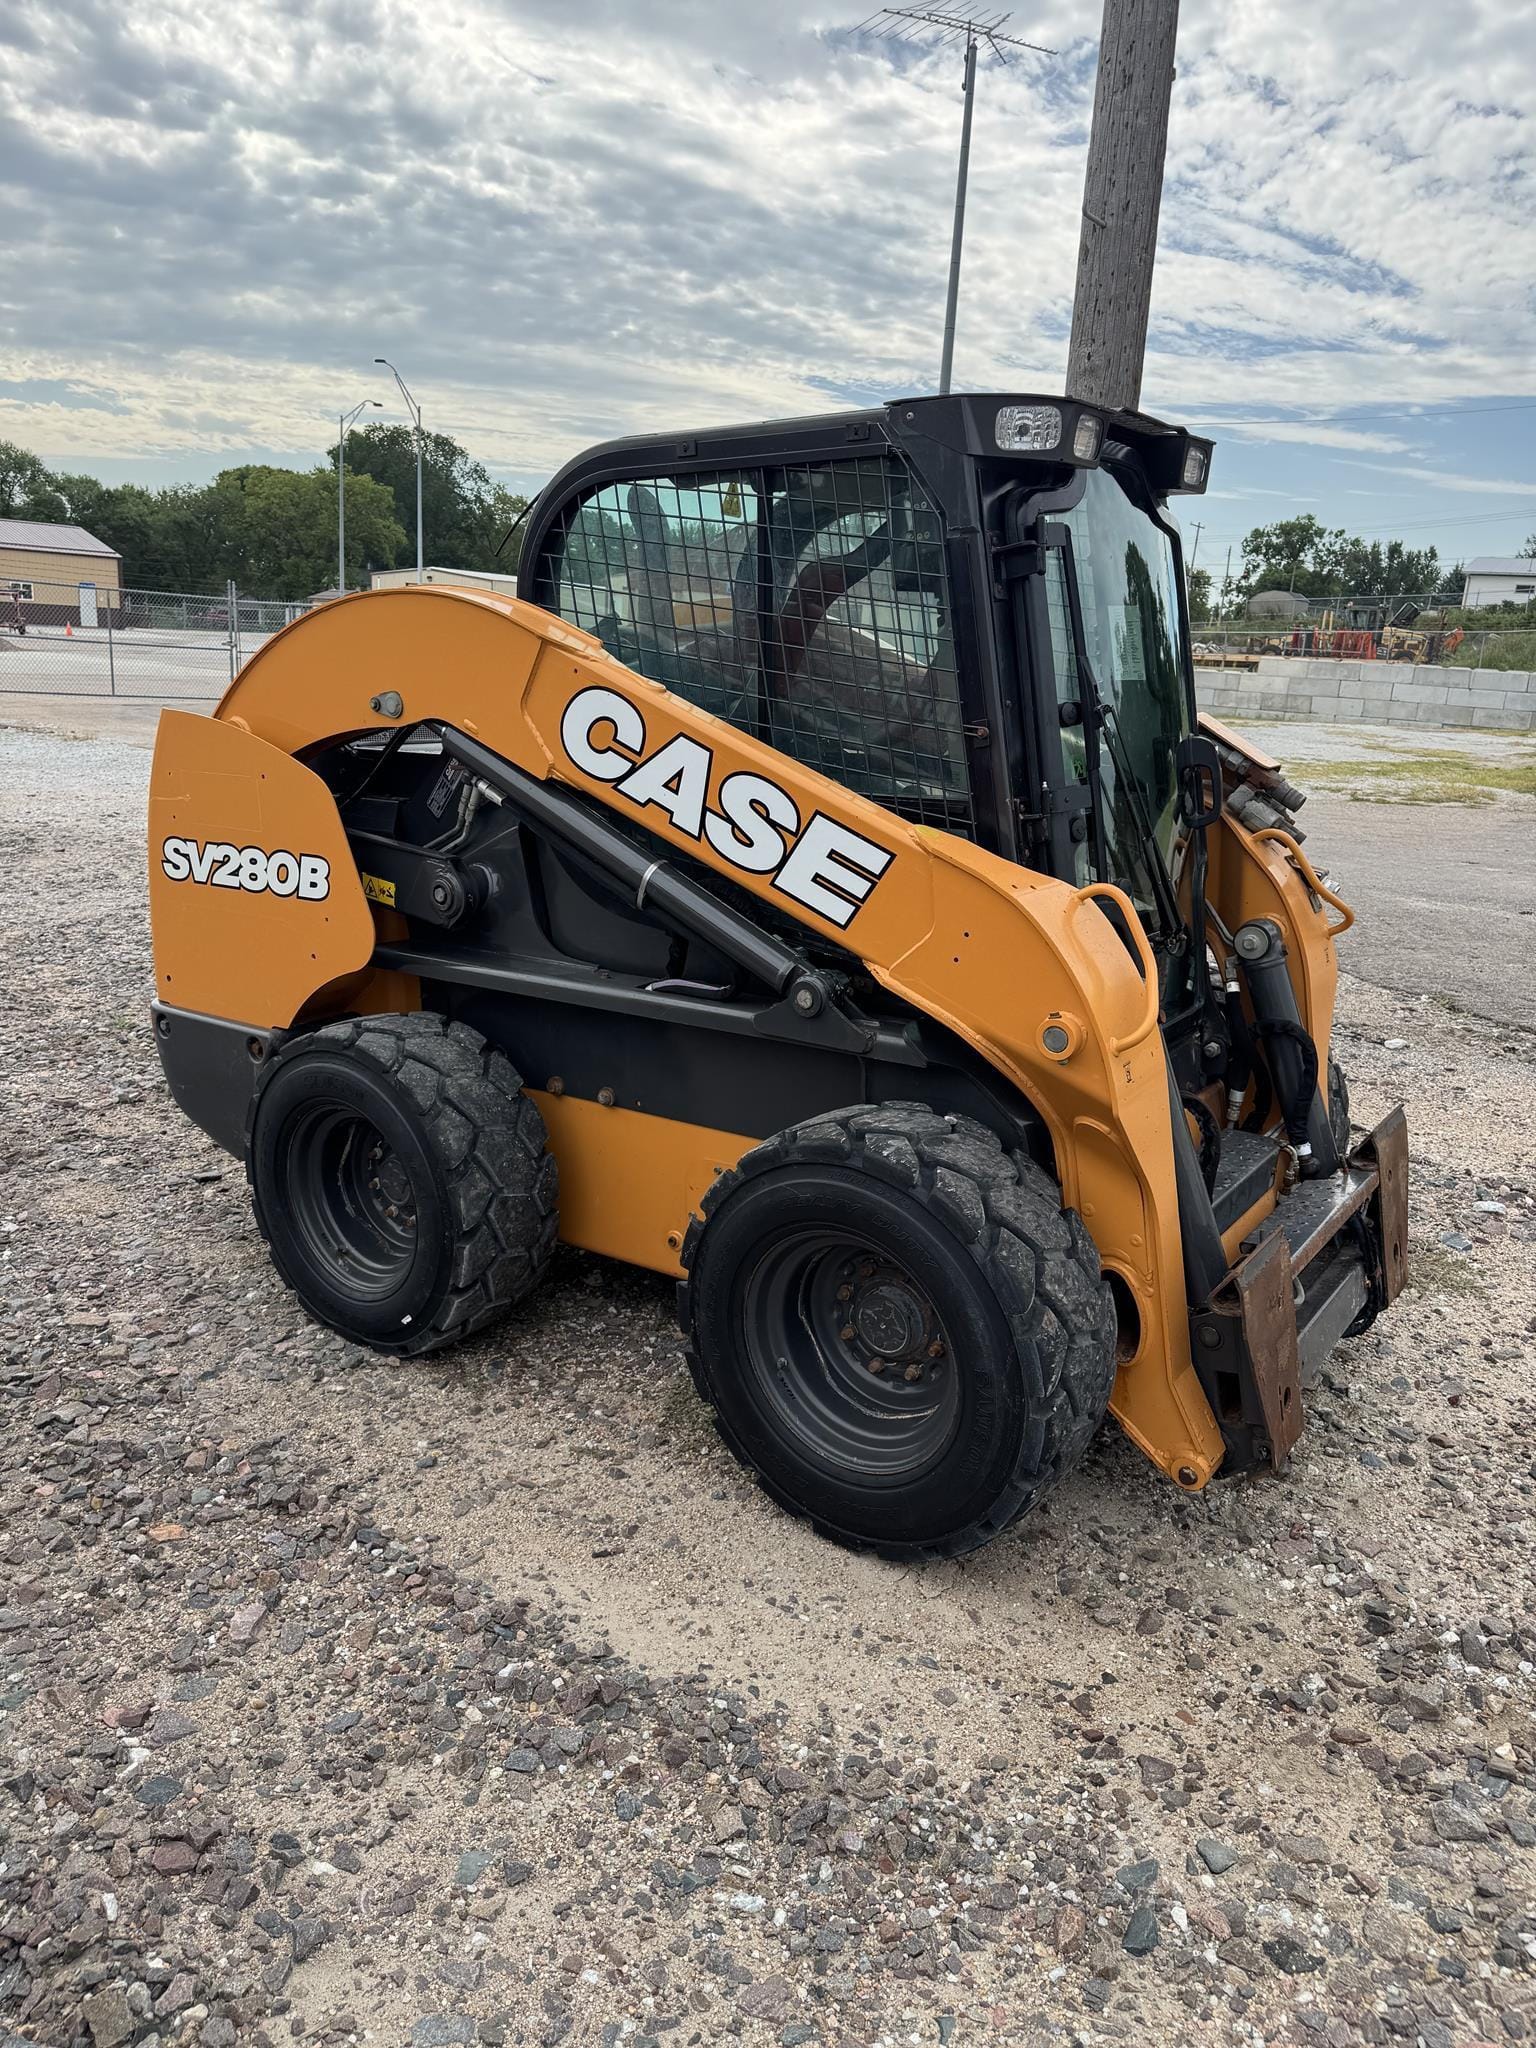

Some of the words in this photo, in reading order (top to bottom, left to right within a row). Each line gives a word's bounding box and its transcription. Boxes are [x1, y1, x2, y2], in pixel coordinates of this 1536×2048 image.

[560, 685, 897, 930] CASE
[161, 836, 331, 902] SV280B
[871, 1214, 940, 1269] DUTY
